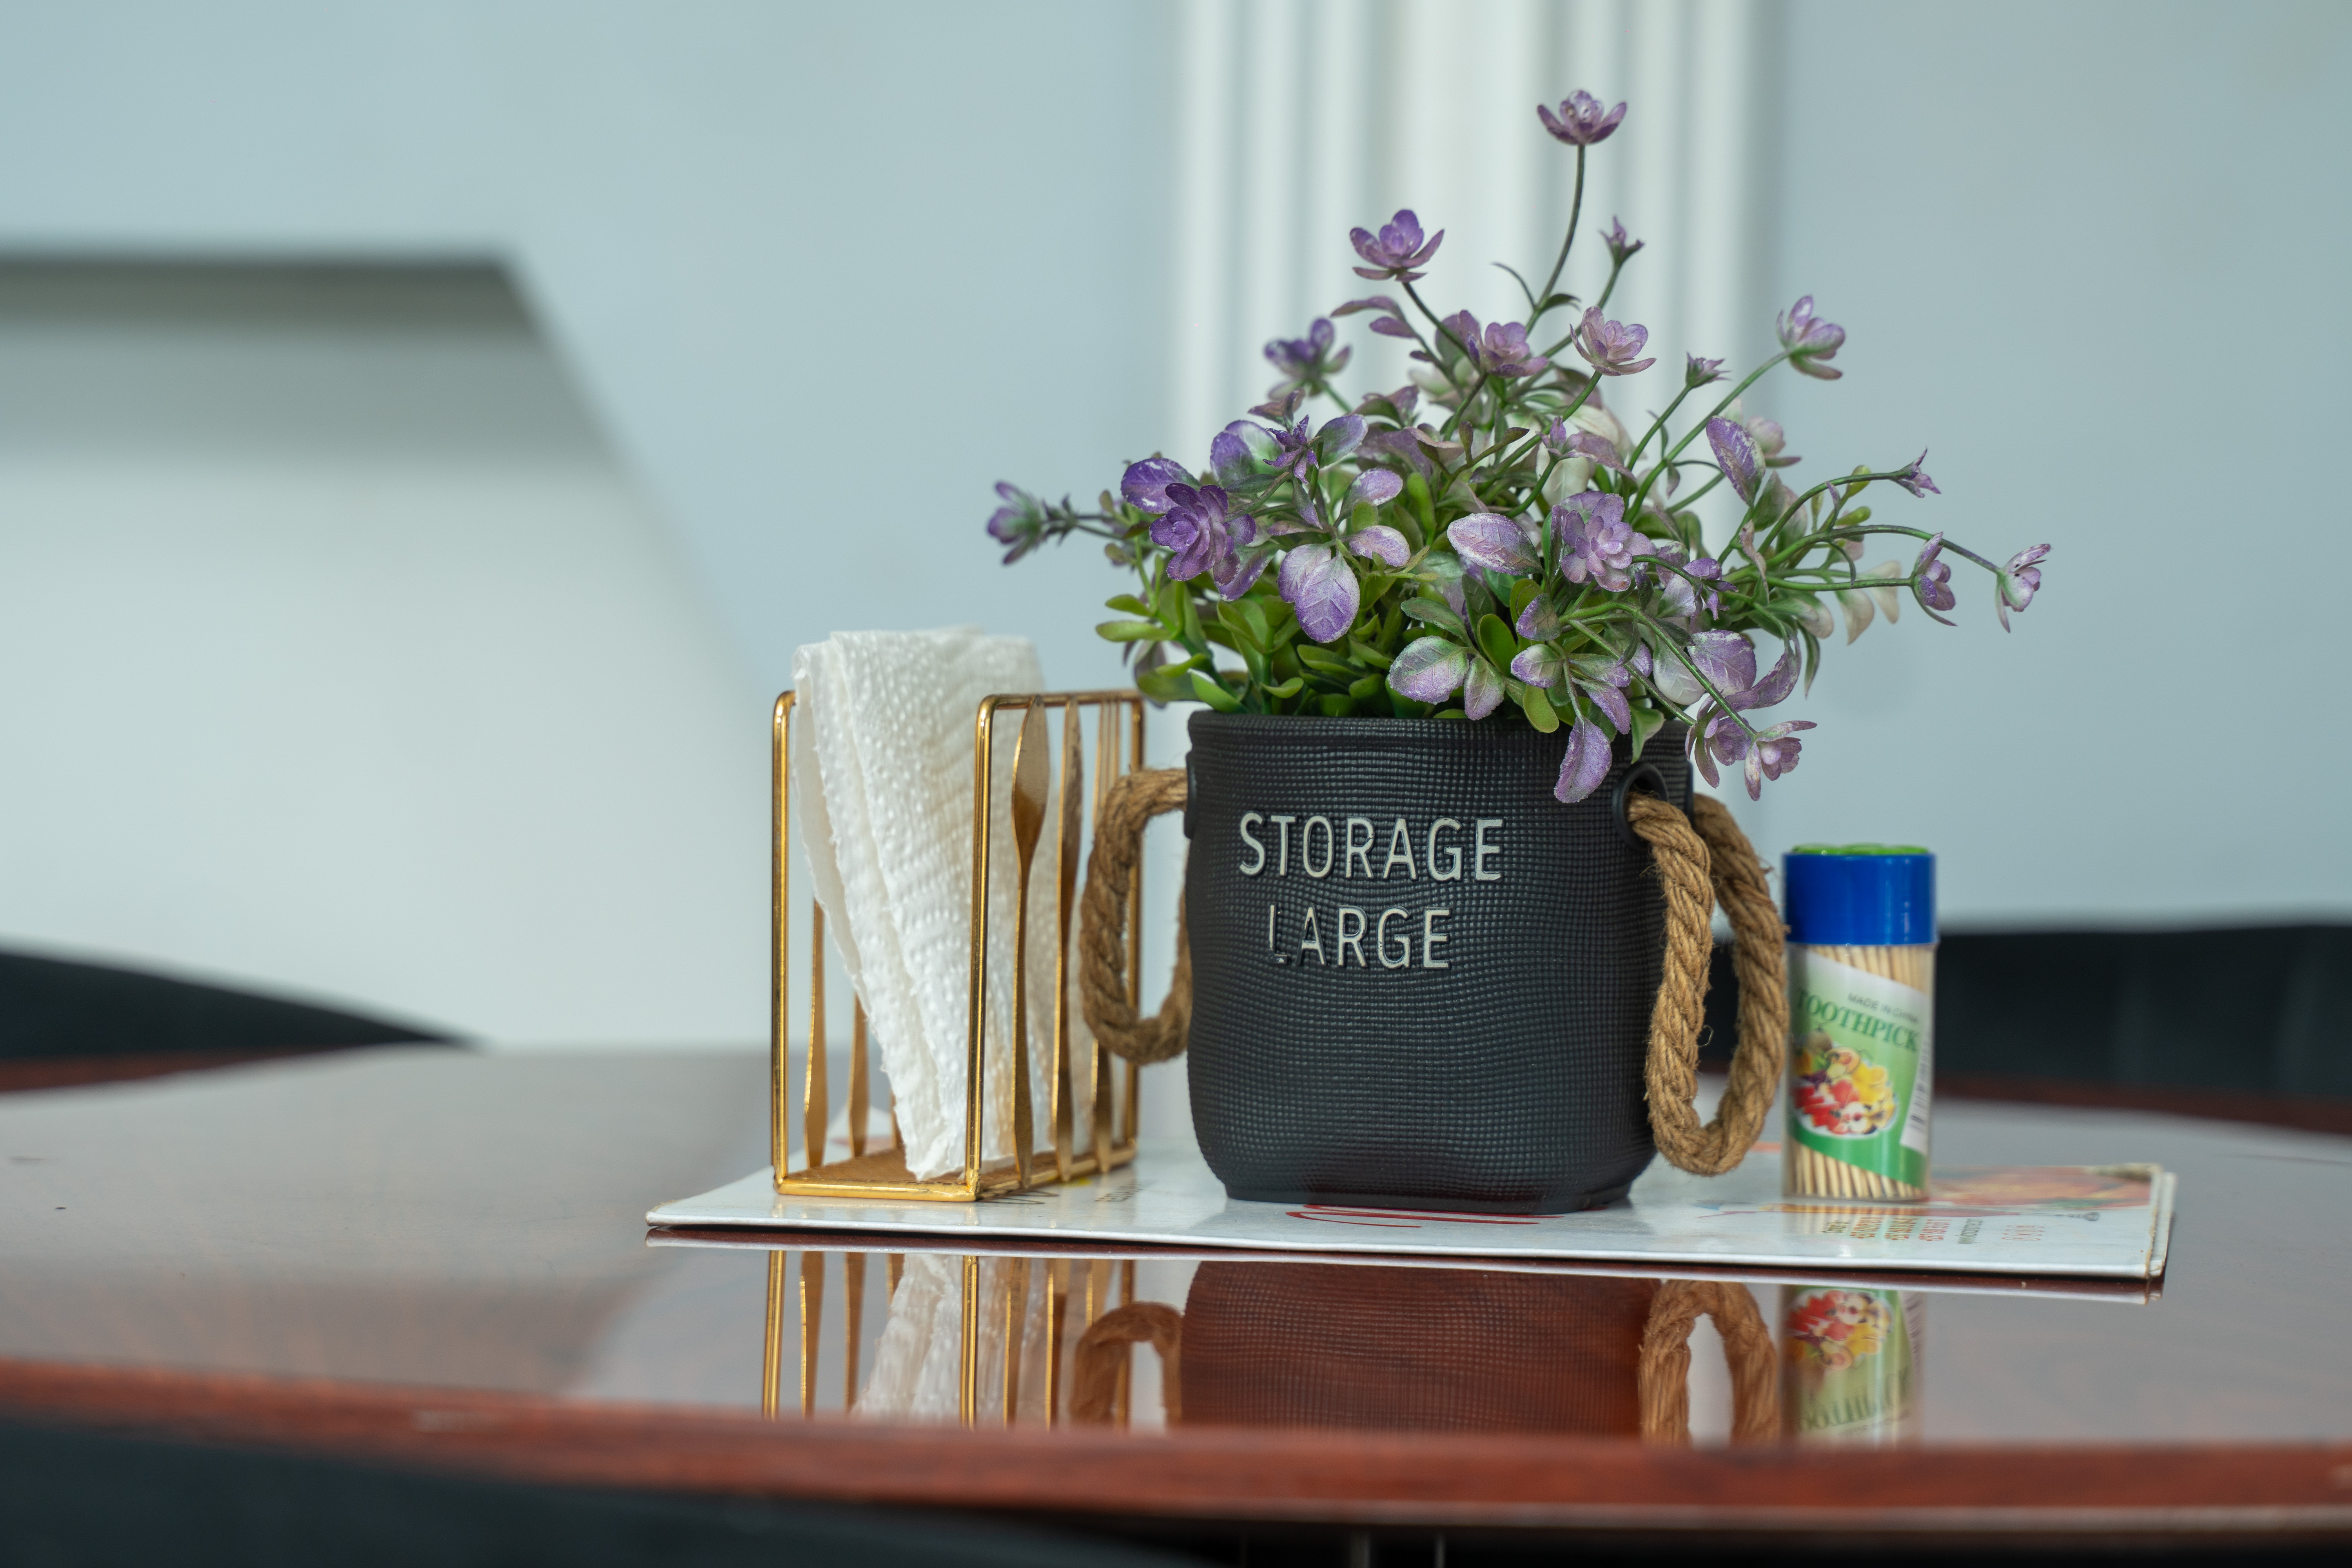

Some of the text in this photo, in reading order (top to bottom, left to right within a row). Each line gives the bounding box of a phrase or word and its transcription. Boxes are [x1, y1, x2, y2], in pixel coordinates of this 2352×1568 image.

[1240, 810, 1505, 882] STORAGE
[1268, 902, 1452, 969] LARGE
[1797, 988, 1920, 1053] TOOTHPICK
[1847, 992, 1919, 1024] MADE IN CHINA
